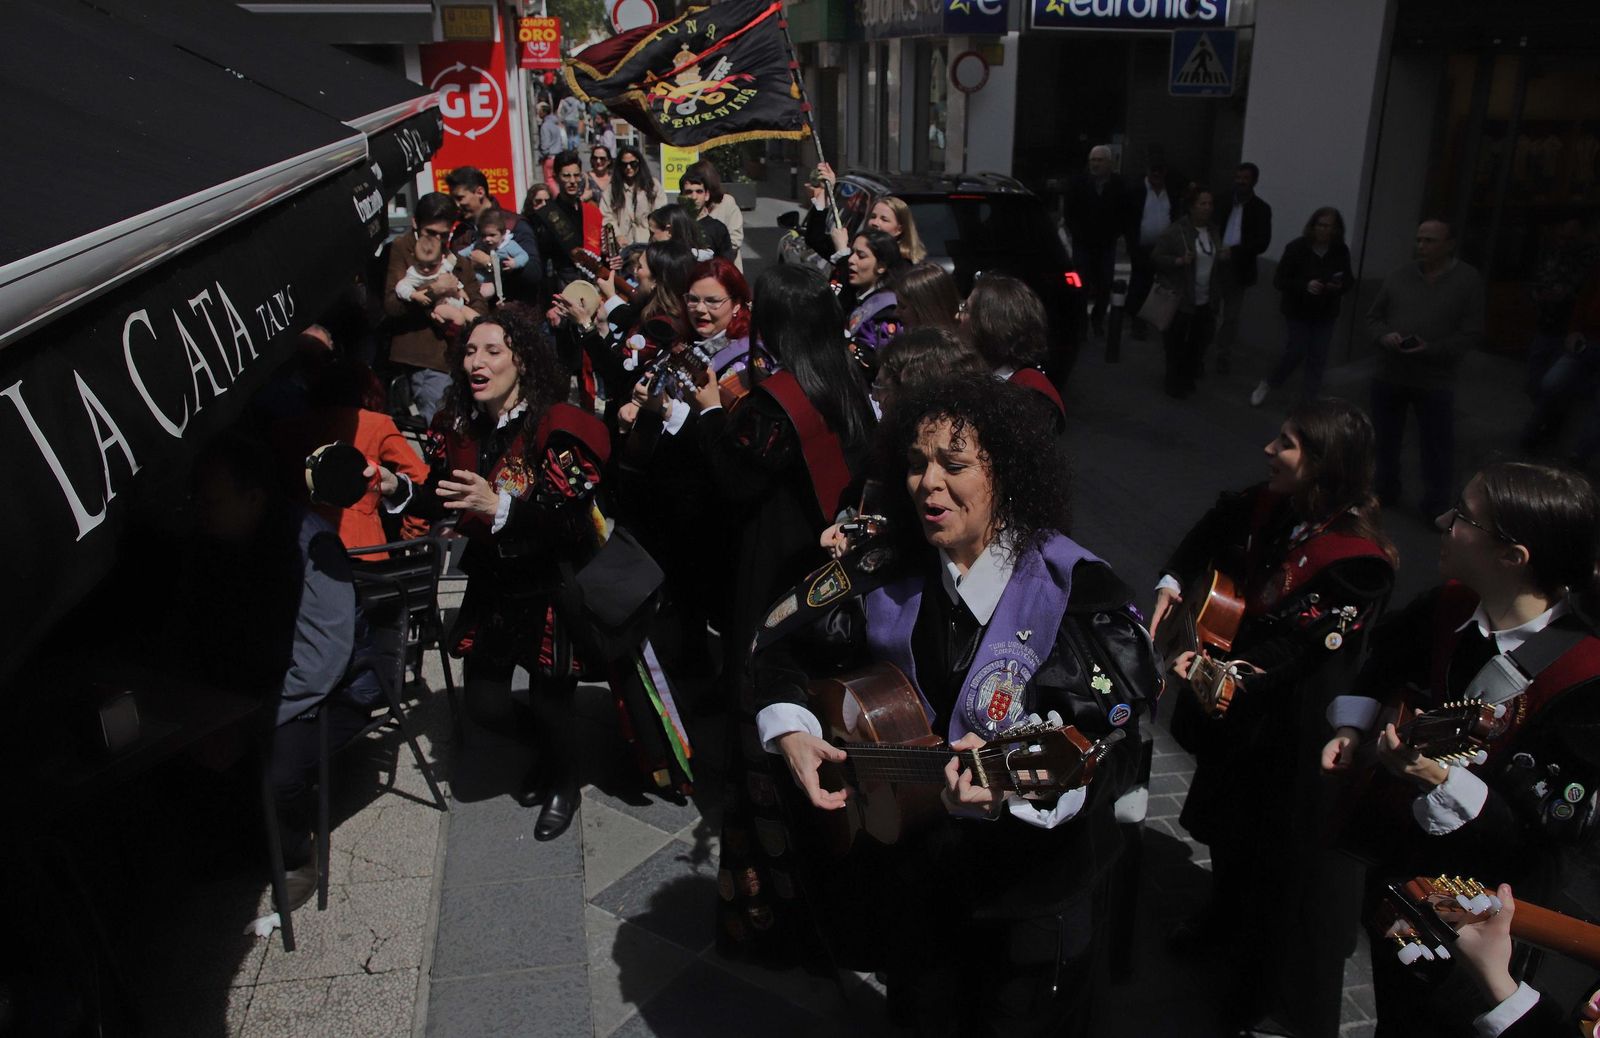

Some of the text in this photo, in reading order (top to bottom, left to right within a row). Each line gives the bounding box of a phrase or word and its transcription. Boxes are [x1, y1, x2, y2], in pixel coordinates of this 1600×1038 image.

[518, 27, 557, 42] ORO
[656, 20, 717, 41] UNA
[438, 82, 494, 119] GE
[659, 88, 757, 129] FEMENINA
[665, 163, 690, 173] OR
[0, 368, 143, 542] LA
[122, 281, 259, 438] CATA
